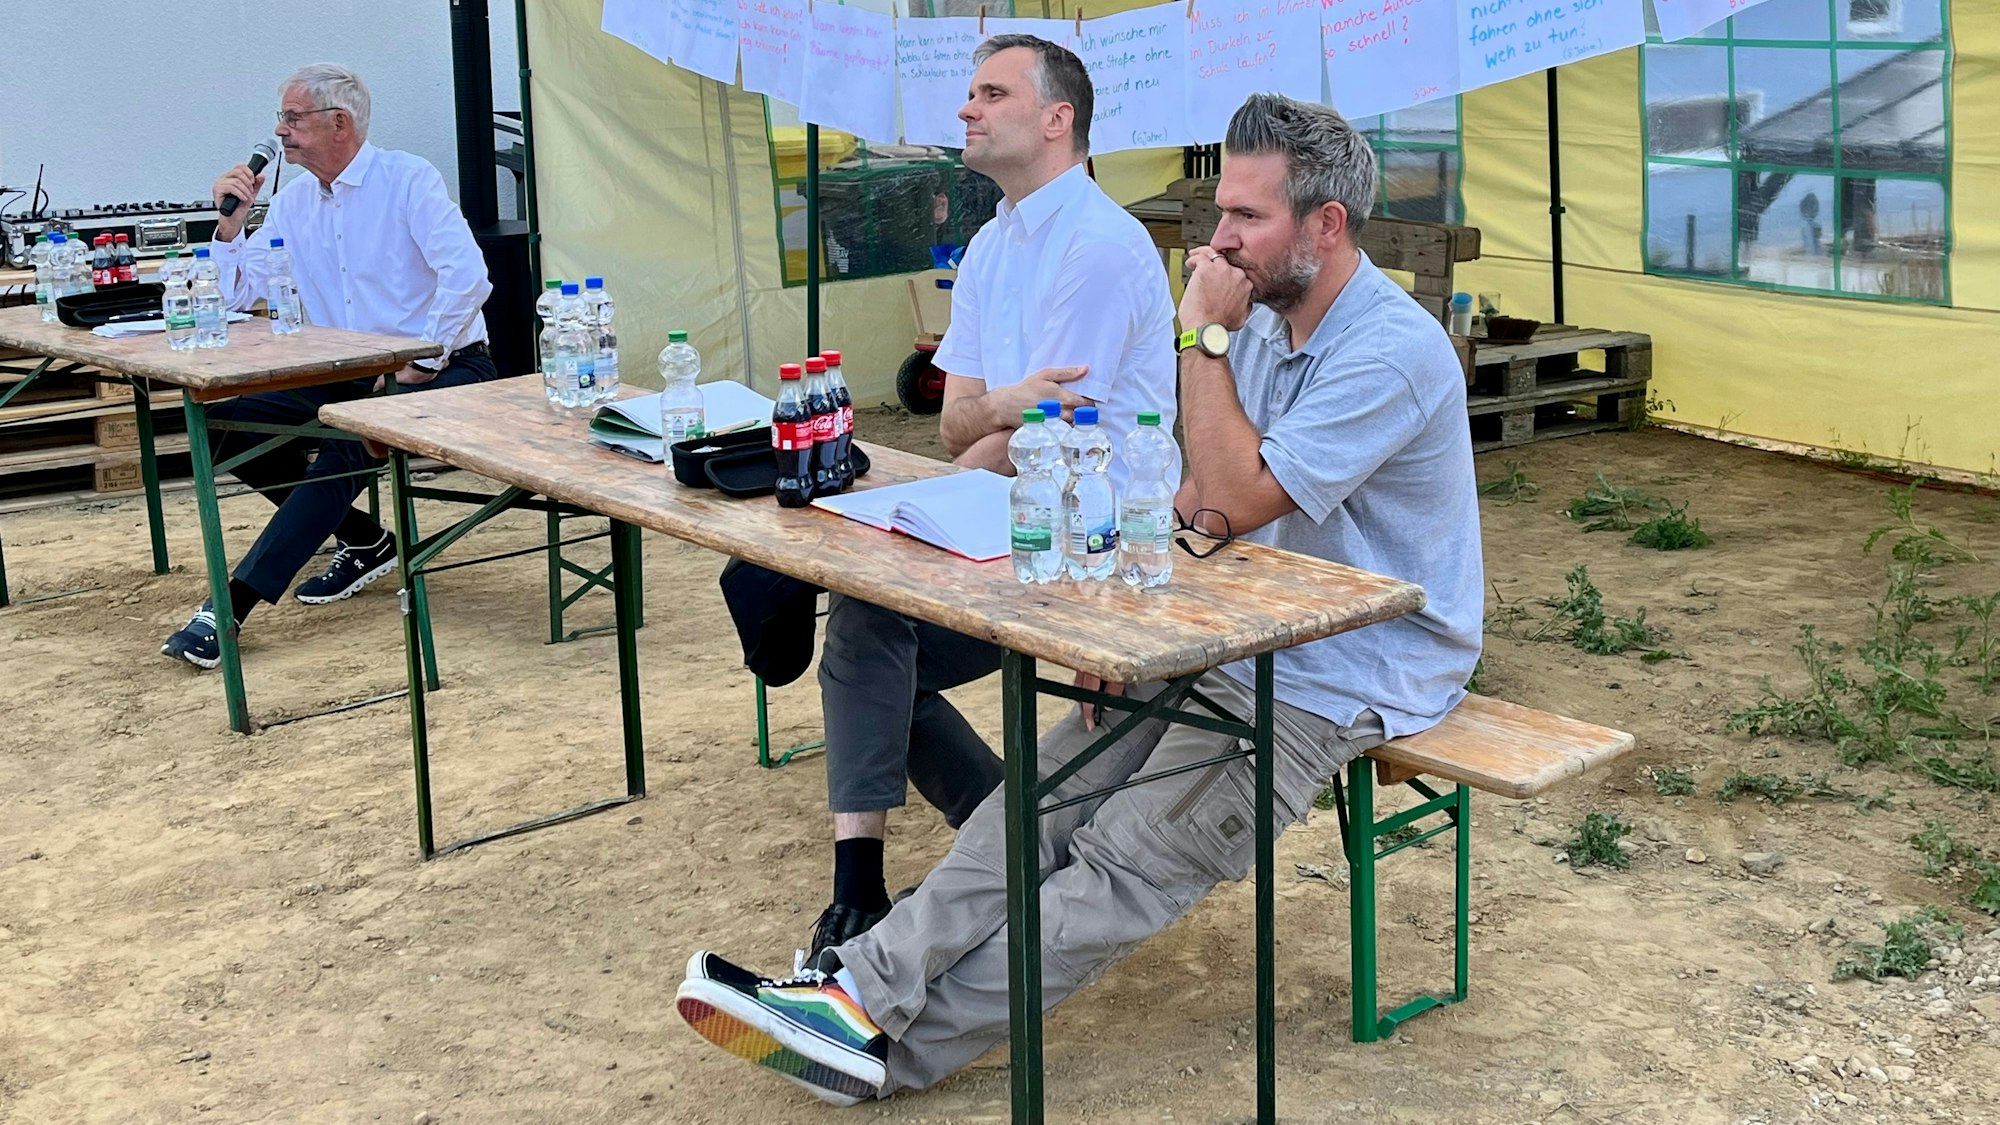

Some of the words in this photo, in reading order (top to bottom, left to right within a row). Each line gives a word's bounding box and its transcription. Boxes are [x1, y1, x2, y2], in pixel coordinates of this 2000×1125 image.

[1190, 10, 1222, 34] Muss
[1234, 8, 1249, 24] ich
[1321, 9, 1378, 36] manche
[1469, 22, 1518, 47] fahren
[1526, 6, 1566, 28] ohne
[946, 32, 958, 44] mit
[1080, 33, 1096, 52] Ich
[1099, 27, 1146, 47] wünsche
[1149, 22, 1168, 36] mir
[1191, 45, 1202, 60] im
[1208, 33, 1251, 55] Dunkeln
[1257, 29, 1276, 42] zur
[1348, 20, 1396, 52] schnell
[1485, 45, 1516, 70] weh
[1524, 40, 1542, 54] zu
[1548, 19, 1587, 45] tun?
[1106, 51, 1137, 69] Straße
[1145, 47, 1174, 62] ohne
[1199, 63, 1229, 79] Schule
[1113, 77, 1130, 95] und
[1135, 78, 1161, 91] neu
